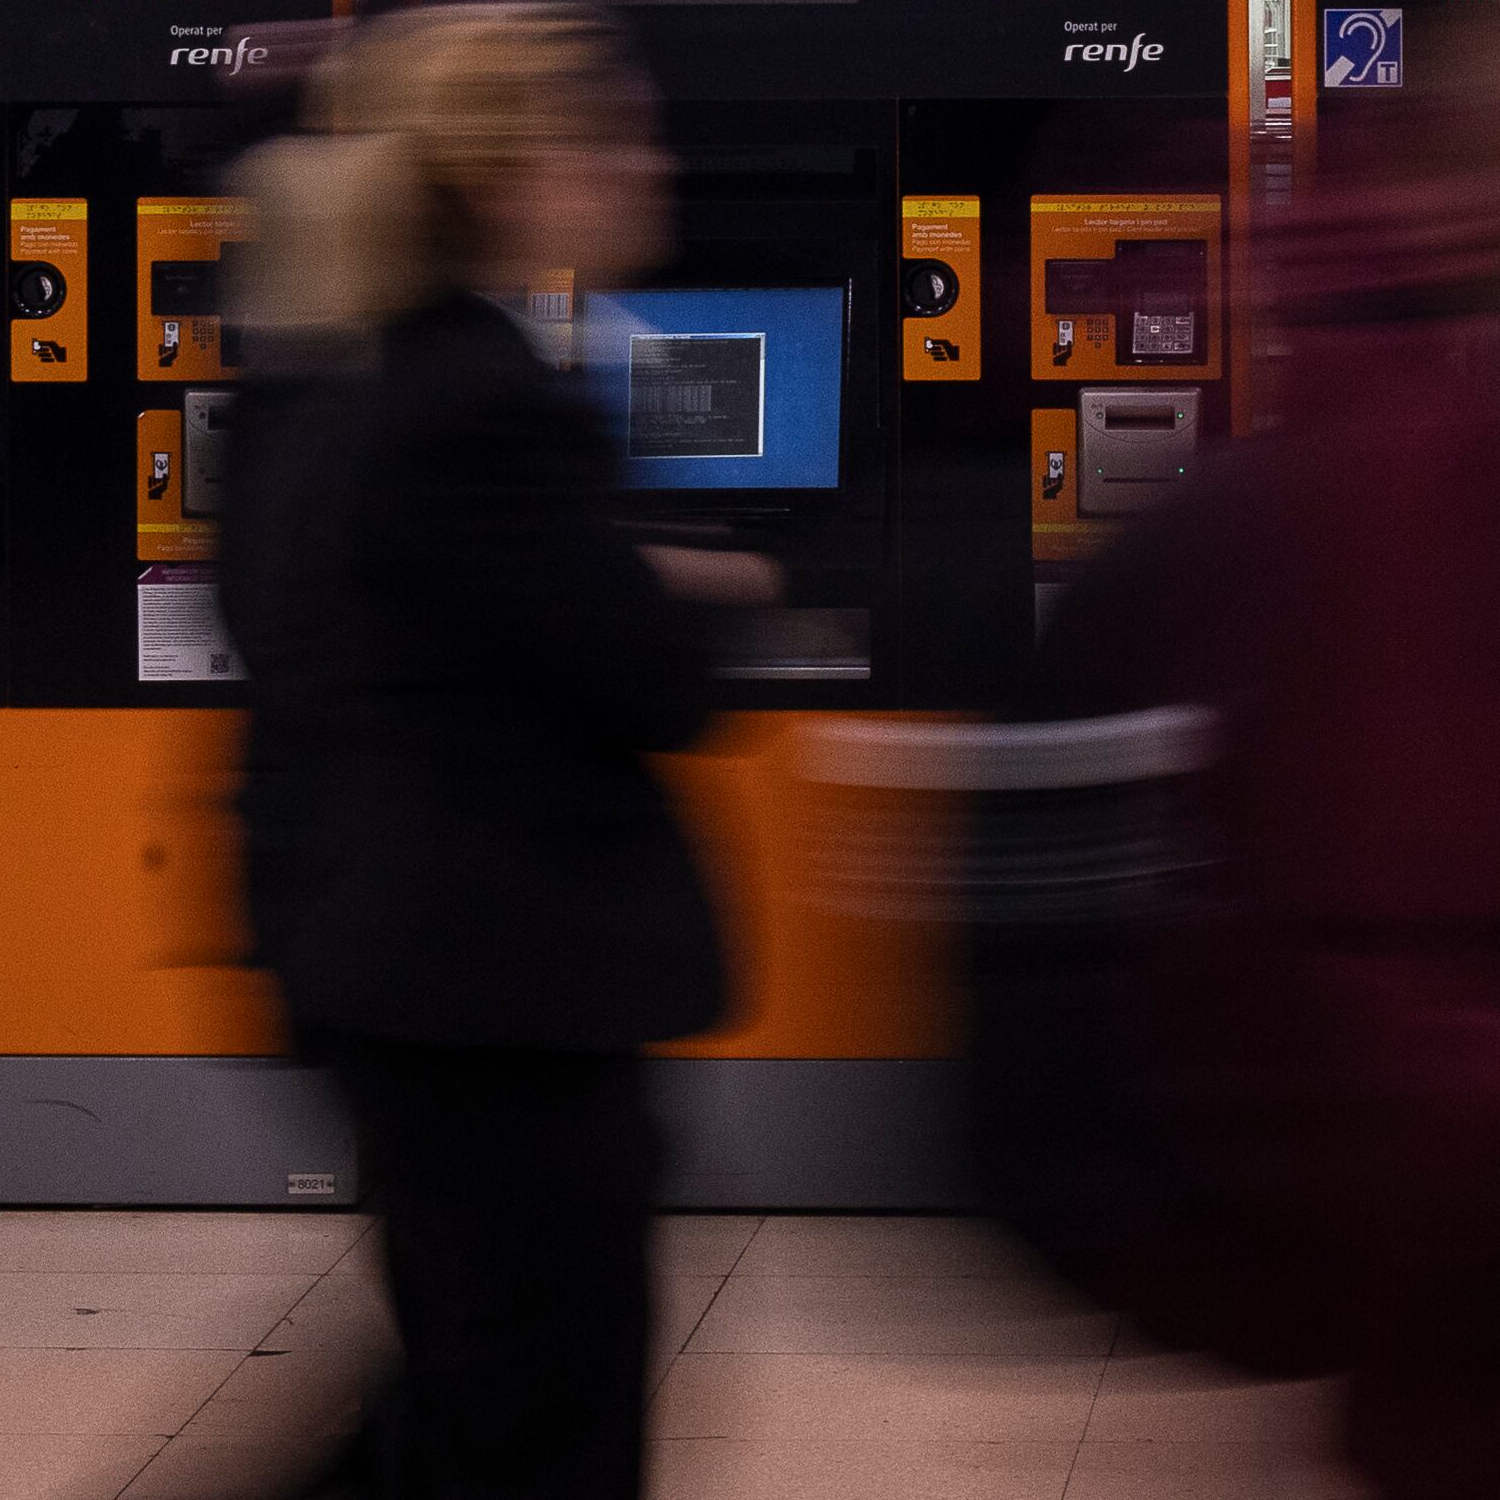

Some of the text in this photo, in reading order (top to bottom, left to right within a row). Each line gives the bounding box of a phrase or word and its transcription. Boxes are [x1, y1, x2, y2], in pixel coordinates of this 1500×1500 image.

[171, 26, 222, 37] Operat per
[1064, 21, 1118, 34] Operat per
[170, 37, 268, 75] renfe
[1064, 34, 1163, 72] renfe
